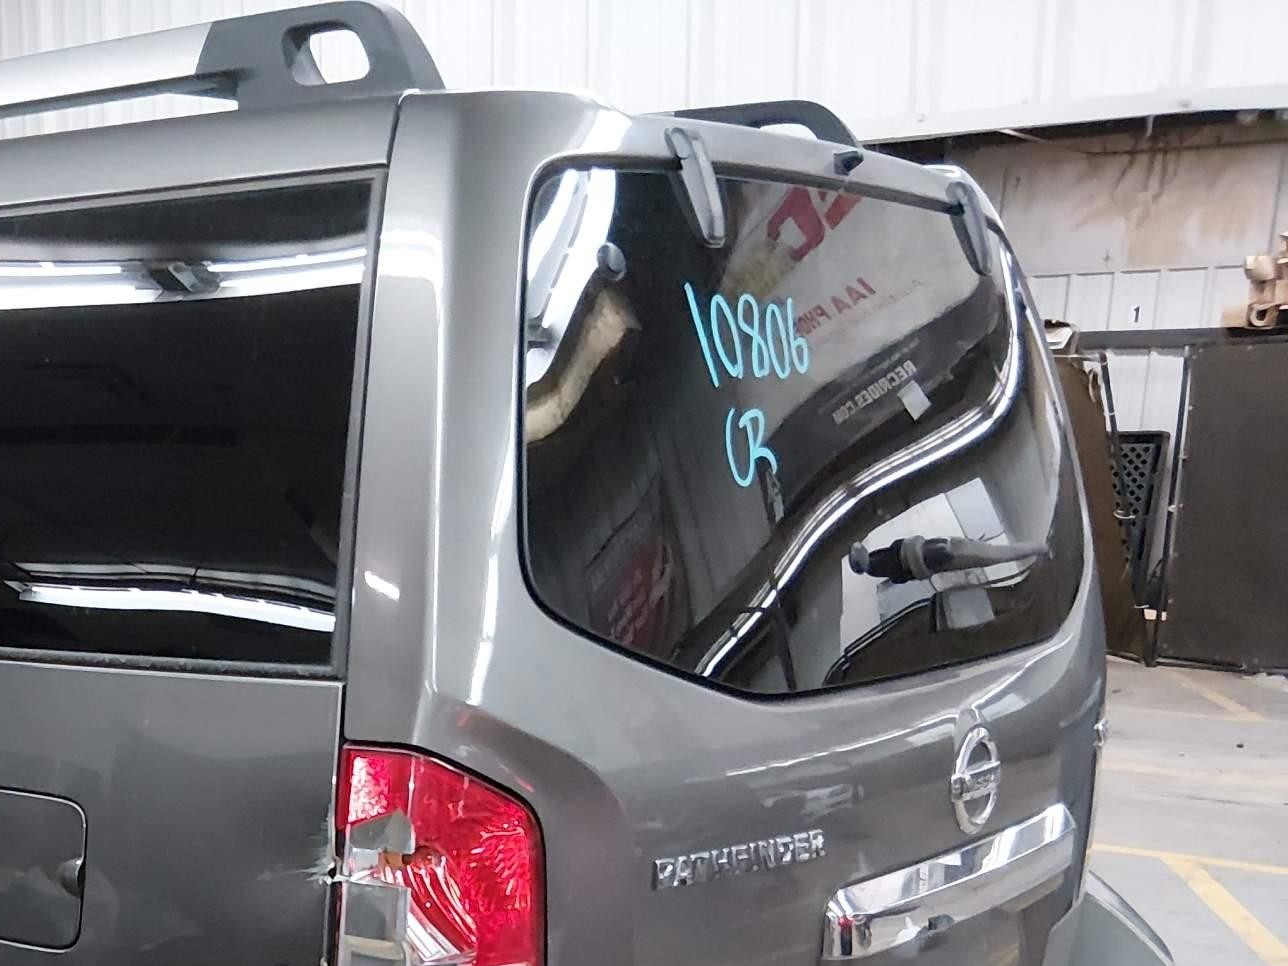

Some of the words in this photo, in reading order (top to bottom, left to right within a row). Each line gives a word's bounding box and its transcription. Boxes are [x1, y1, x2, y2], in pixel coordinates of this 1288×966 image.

[684, 281, 809, 389] 10806
[1131, 304, 1142, 323] 1
[651, 828, 826, 891] PATHFINDER
